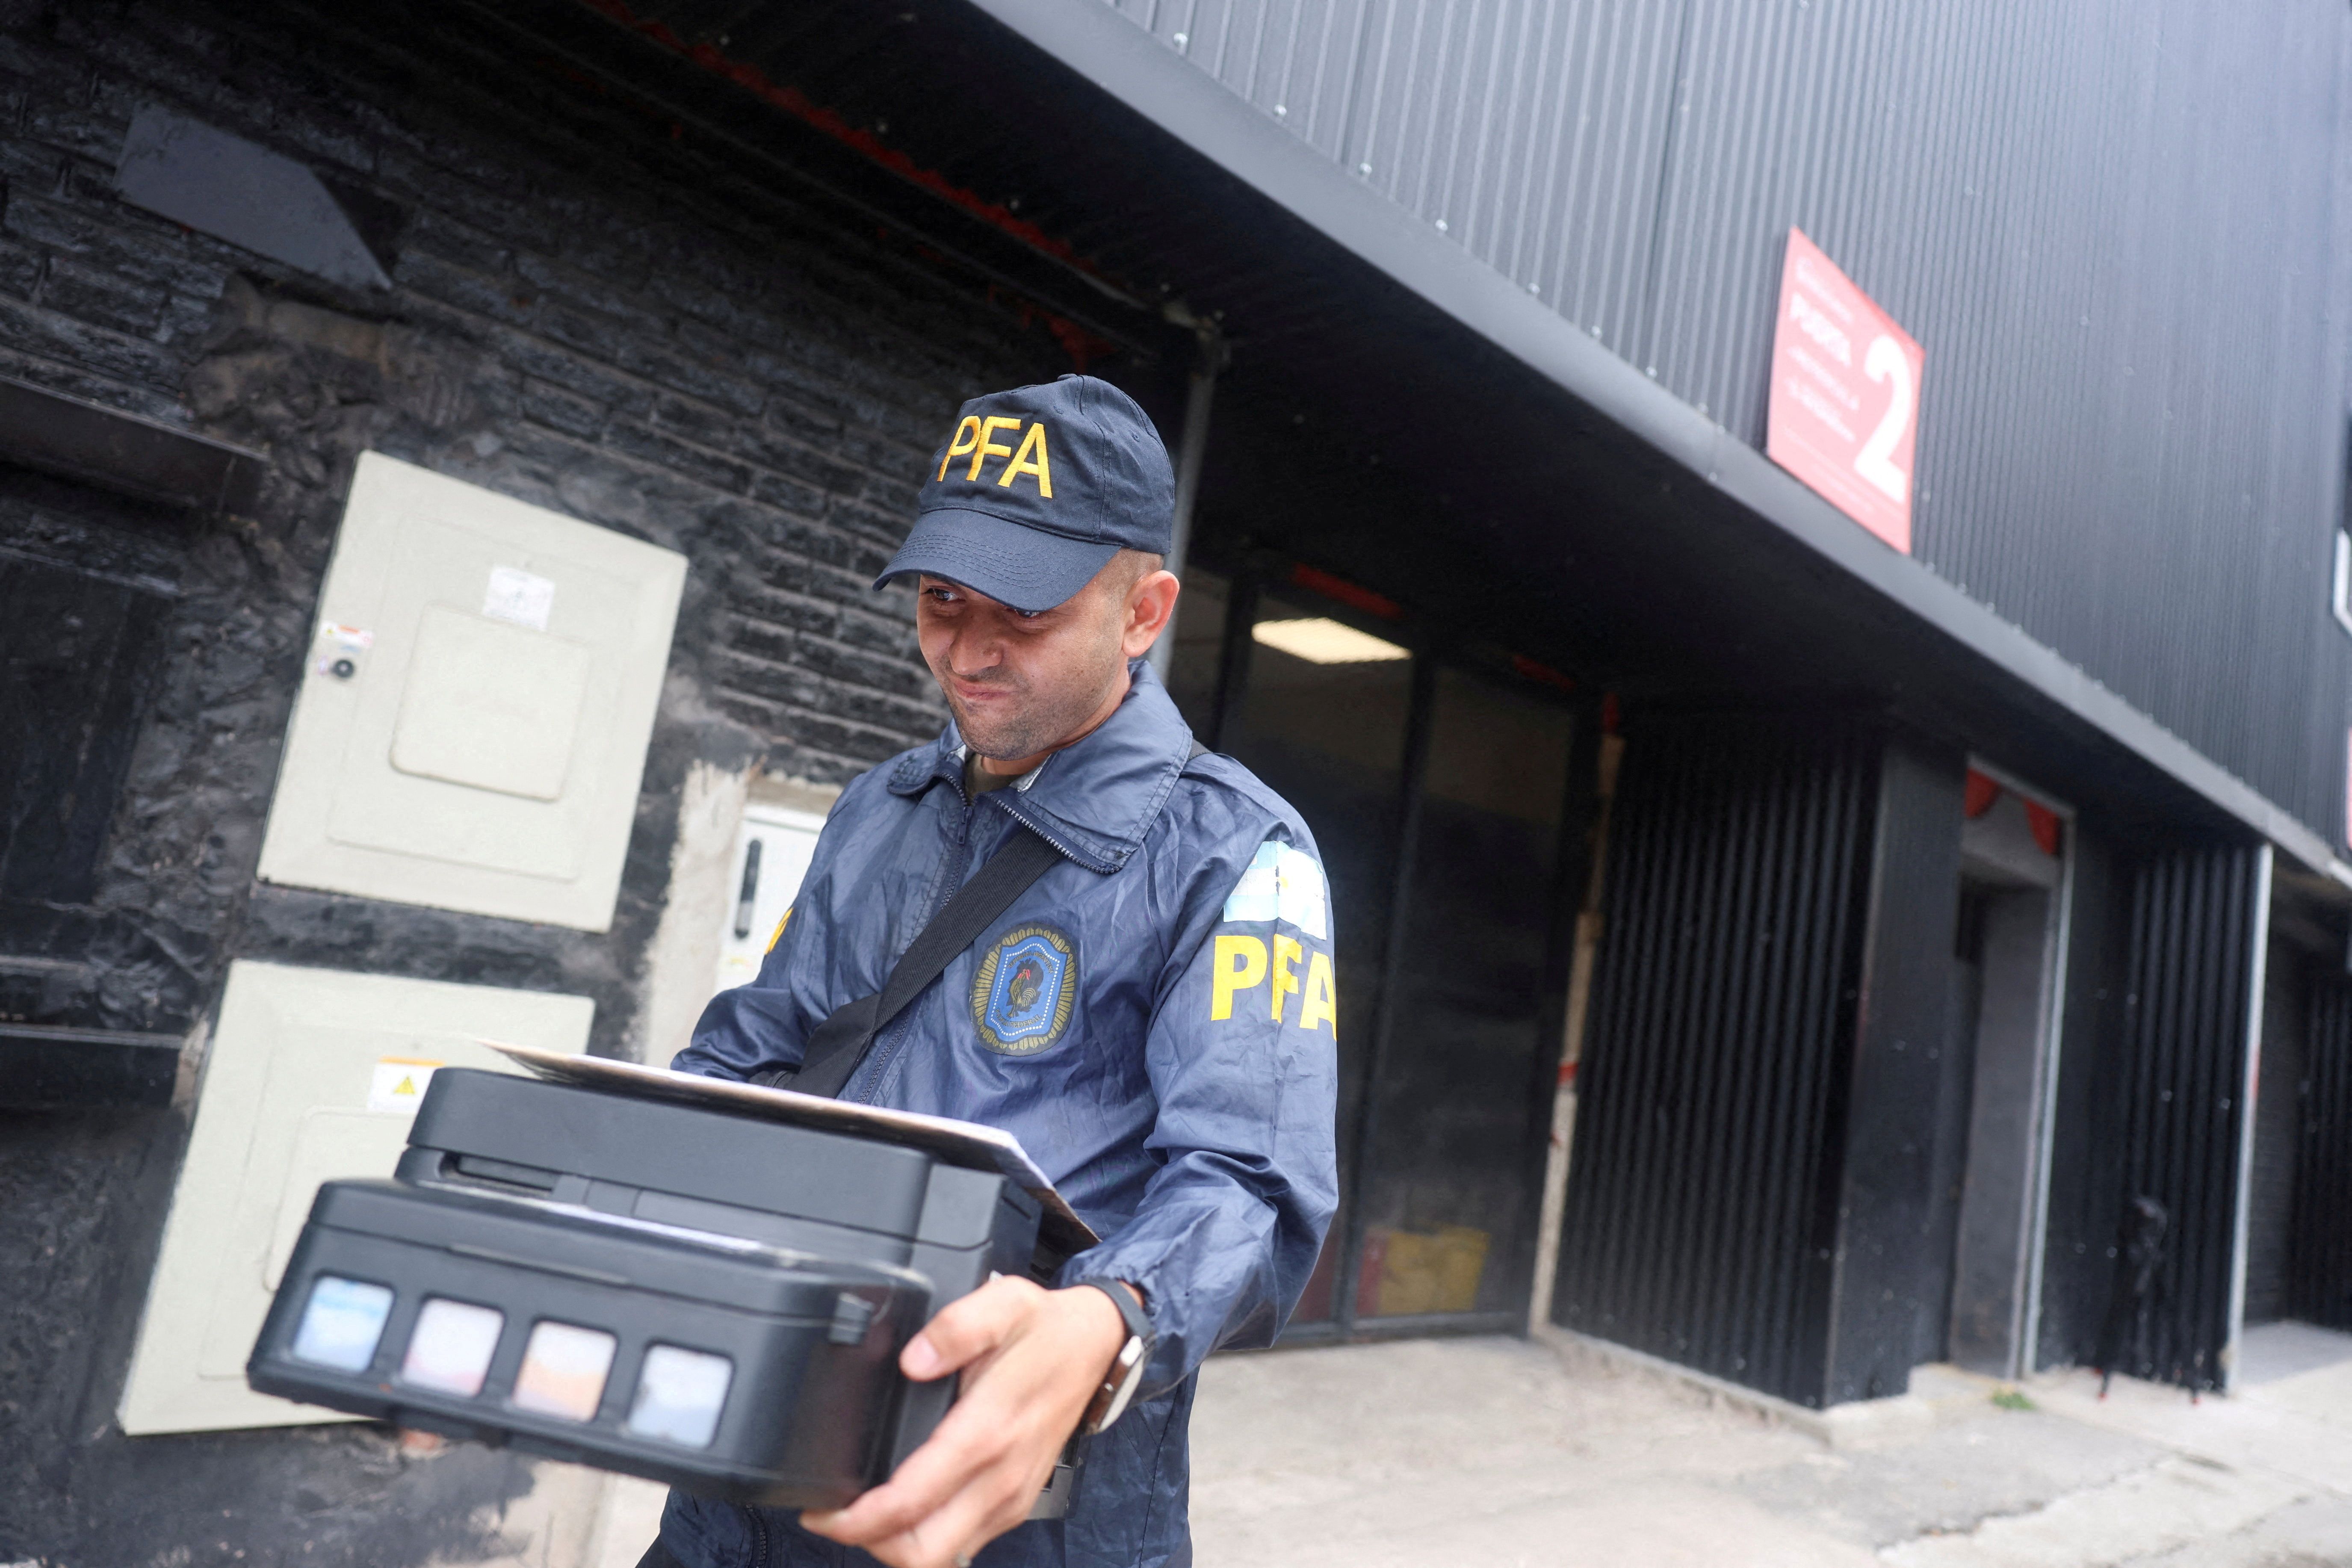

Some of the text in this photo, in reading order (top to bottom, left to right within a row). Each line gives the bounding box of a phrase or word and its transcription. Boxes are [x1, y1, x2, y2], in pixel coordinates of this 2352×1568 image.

[937, 416, 1052, 498] PFA
[1854, 333, 1912, 503] 2
[1032, 950, 1054, 974] ARGENTINA
[1211, 934, 1337, 1042] PFA
[1009, 1014, 1043, 1028] FEDERAL
